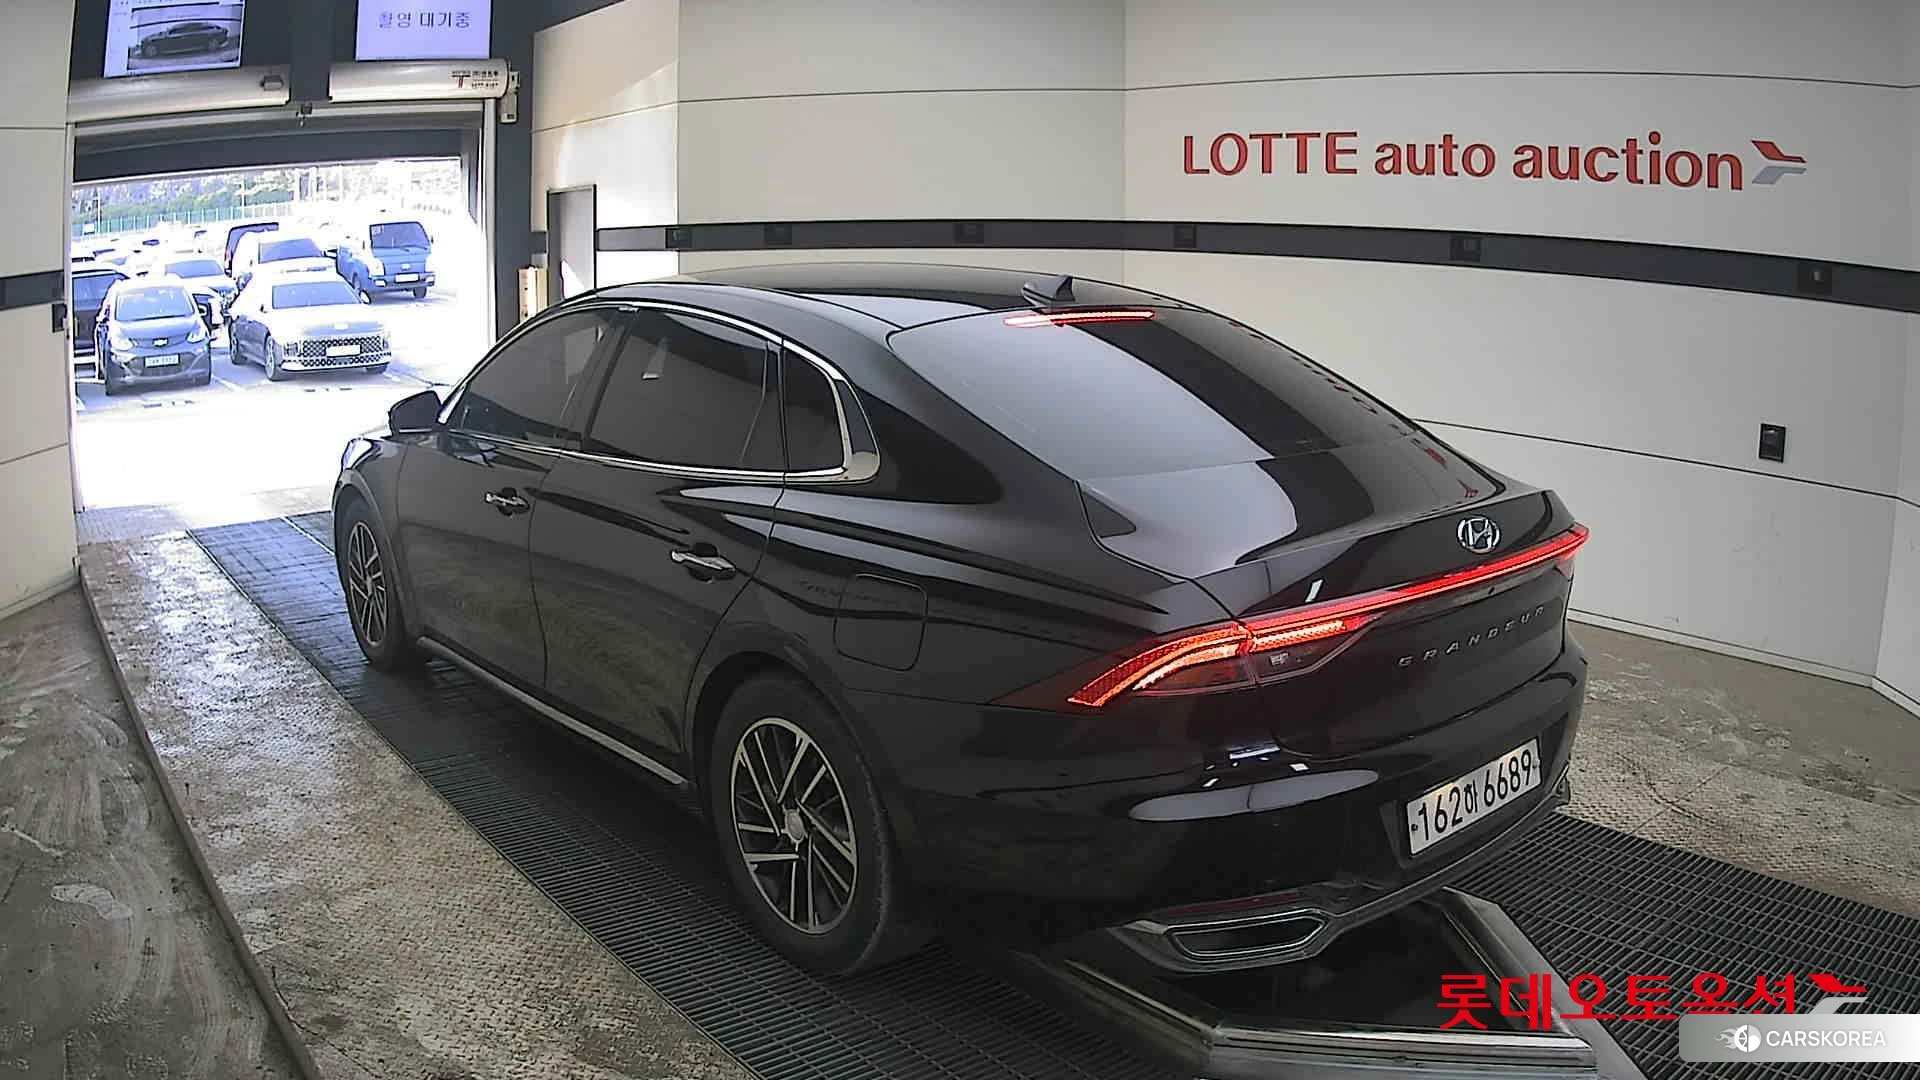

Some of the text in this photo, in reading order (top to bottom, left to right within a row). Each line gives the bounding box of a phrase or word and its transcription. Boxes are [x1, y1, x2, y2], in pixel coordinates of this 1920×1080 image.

[420, 11, 470, 28] 대기중
[1184, 131, 1743, 190] LOTTE auto auction
[1399, 605, 1544, 666] GRANDEUR
